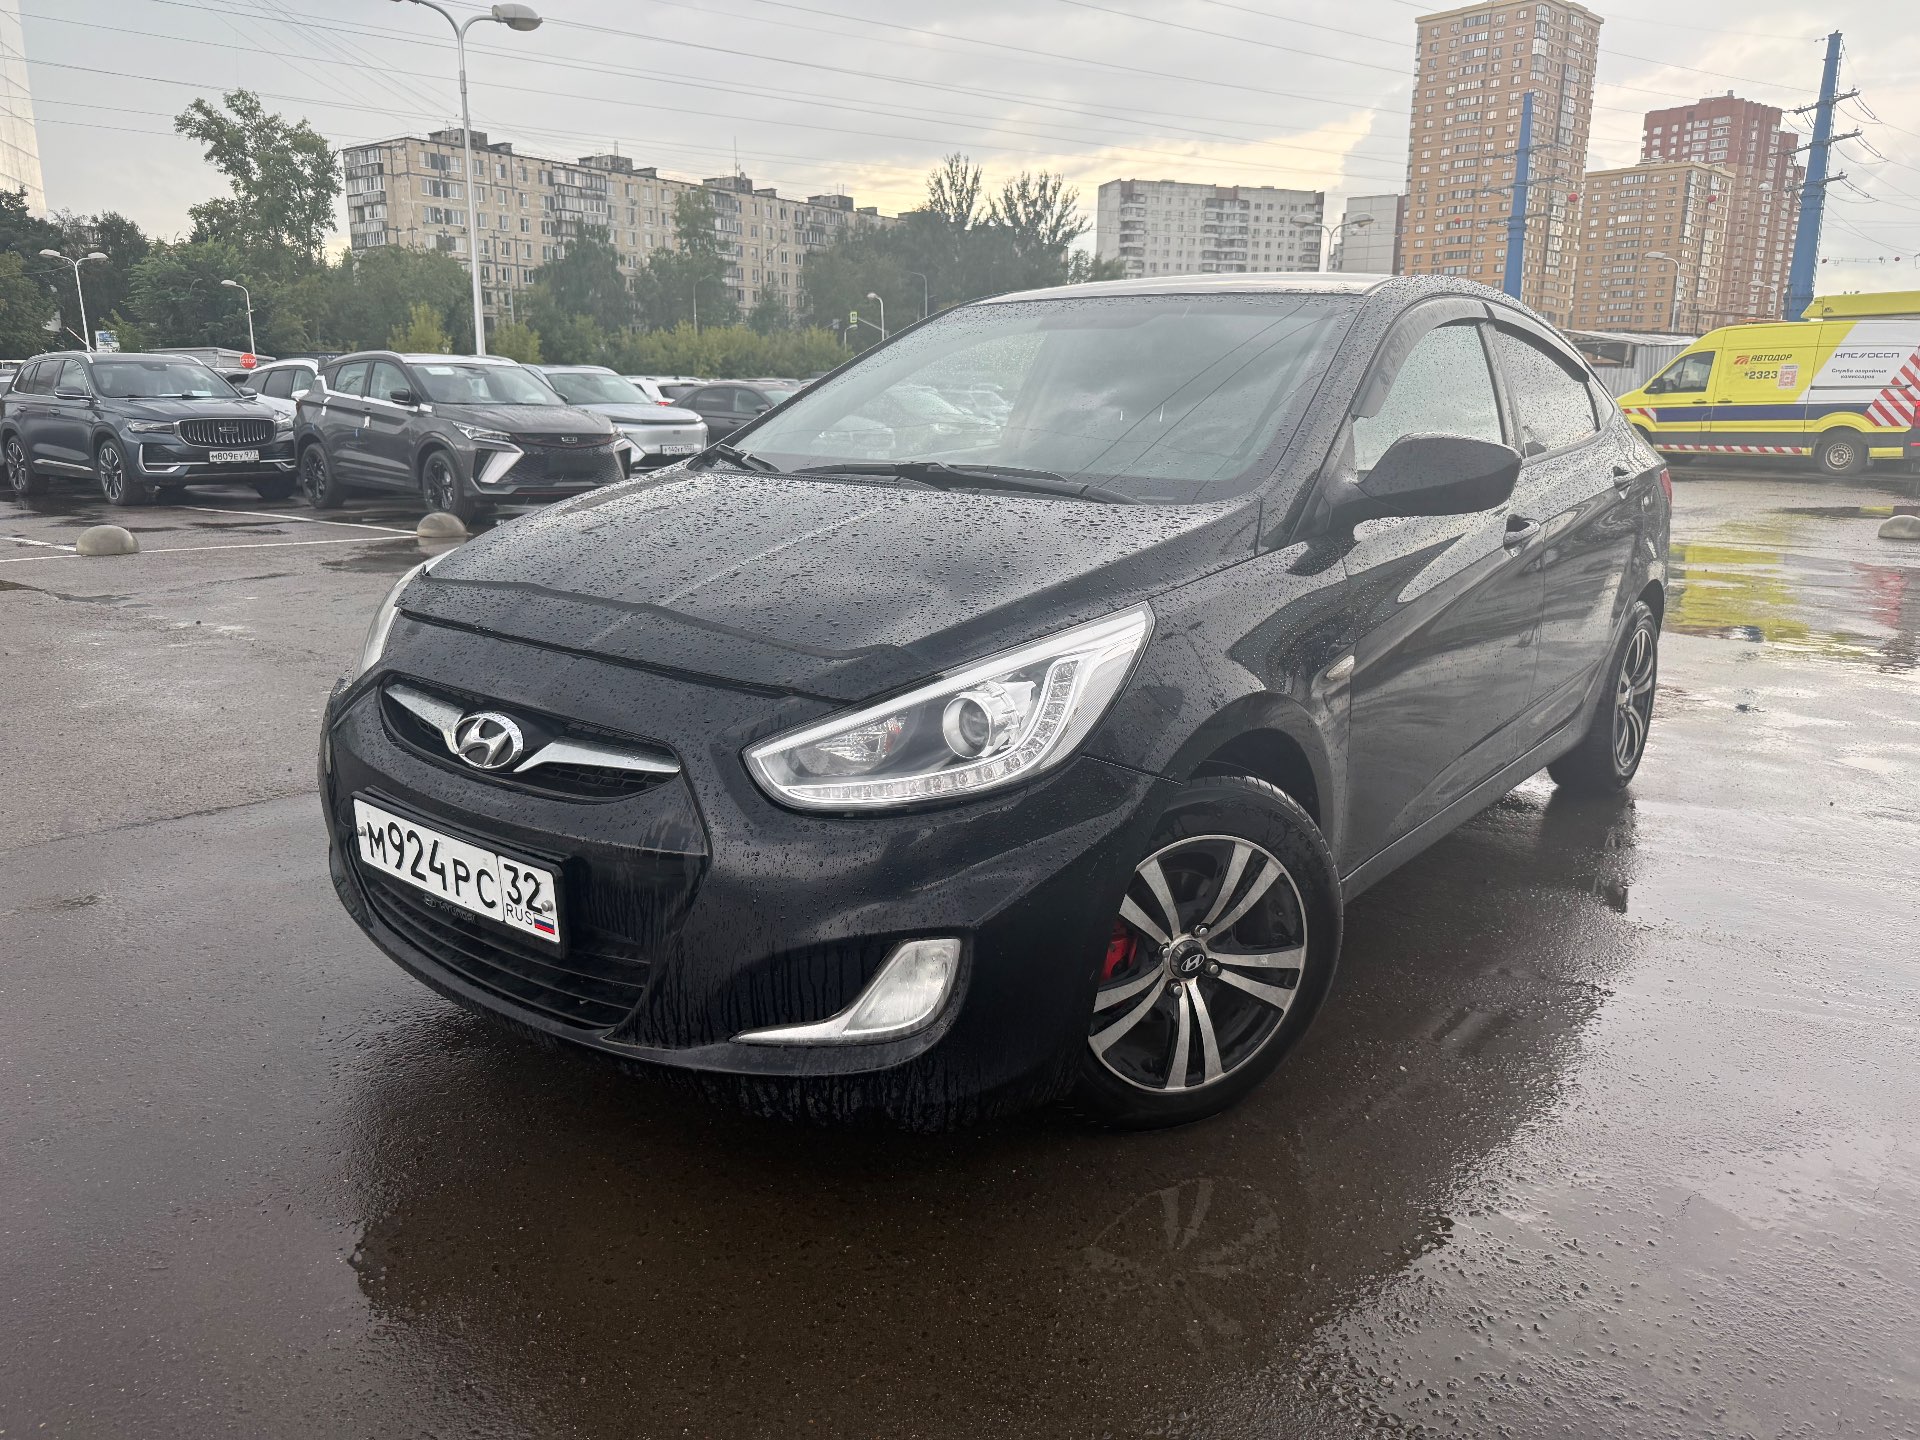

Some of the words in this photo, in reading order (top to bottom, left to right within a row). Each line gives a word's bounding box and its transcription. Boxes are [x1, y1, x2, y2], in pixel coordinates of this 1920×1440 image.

[1750, 353, 1793, 362] АВТОДОР
[503, 863, 543, 914] 32
[505, 902, 533, 926] RUS
